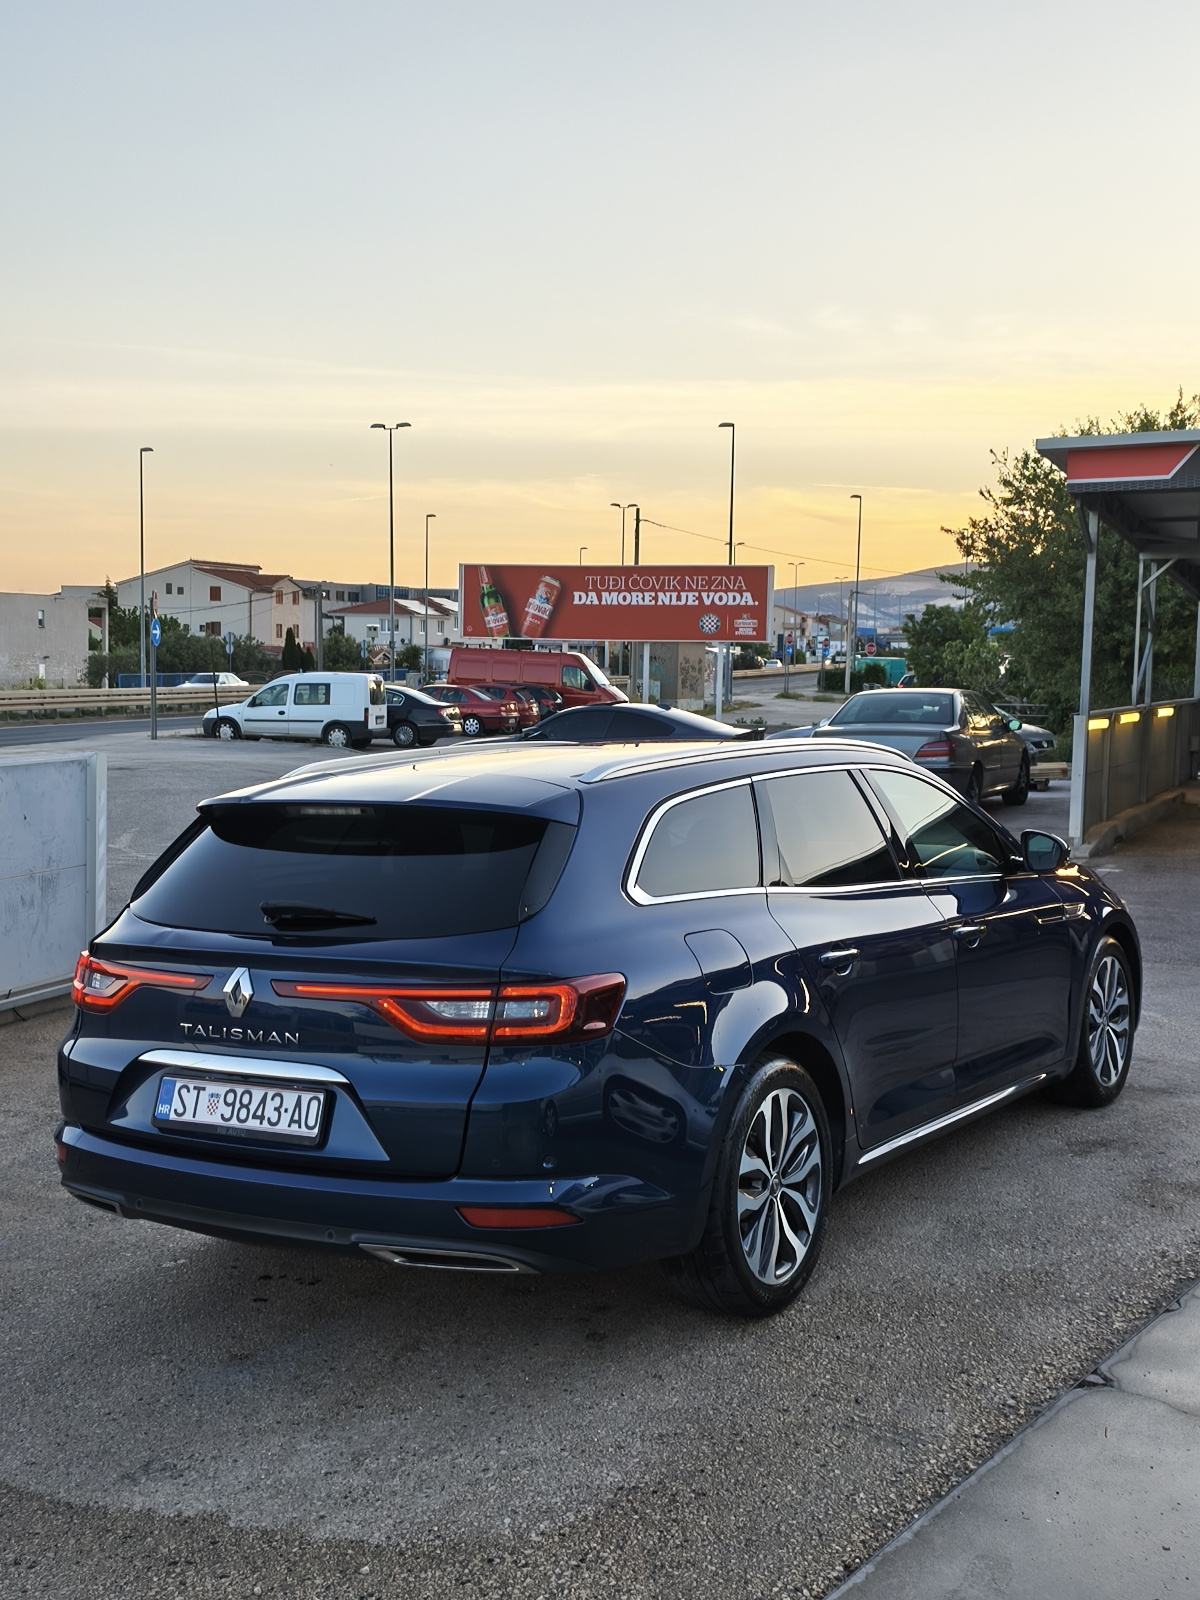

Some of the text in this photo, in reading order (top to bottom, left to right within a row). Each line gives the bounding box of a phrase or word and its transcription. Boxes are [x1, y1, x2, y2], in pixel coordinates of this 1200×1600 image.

[585, 572, 747, 590] TUĐI ČOVIK NE ZNA
[573, 591, 759, 606] DA MORE NIJE VODA.
[180, 1022, 300, 1045] TALISMAN
[158, 1103, 171, 1115] HR
[173, 1084, 206, 1119] ST
